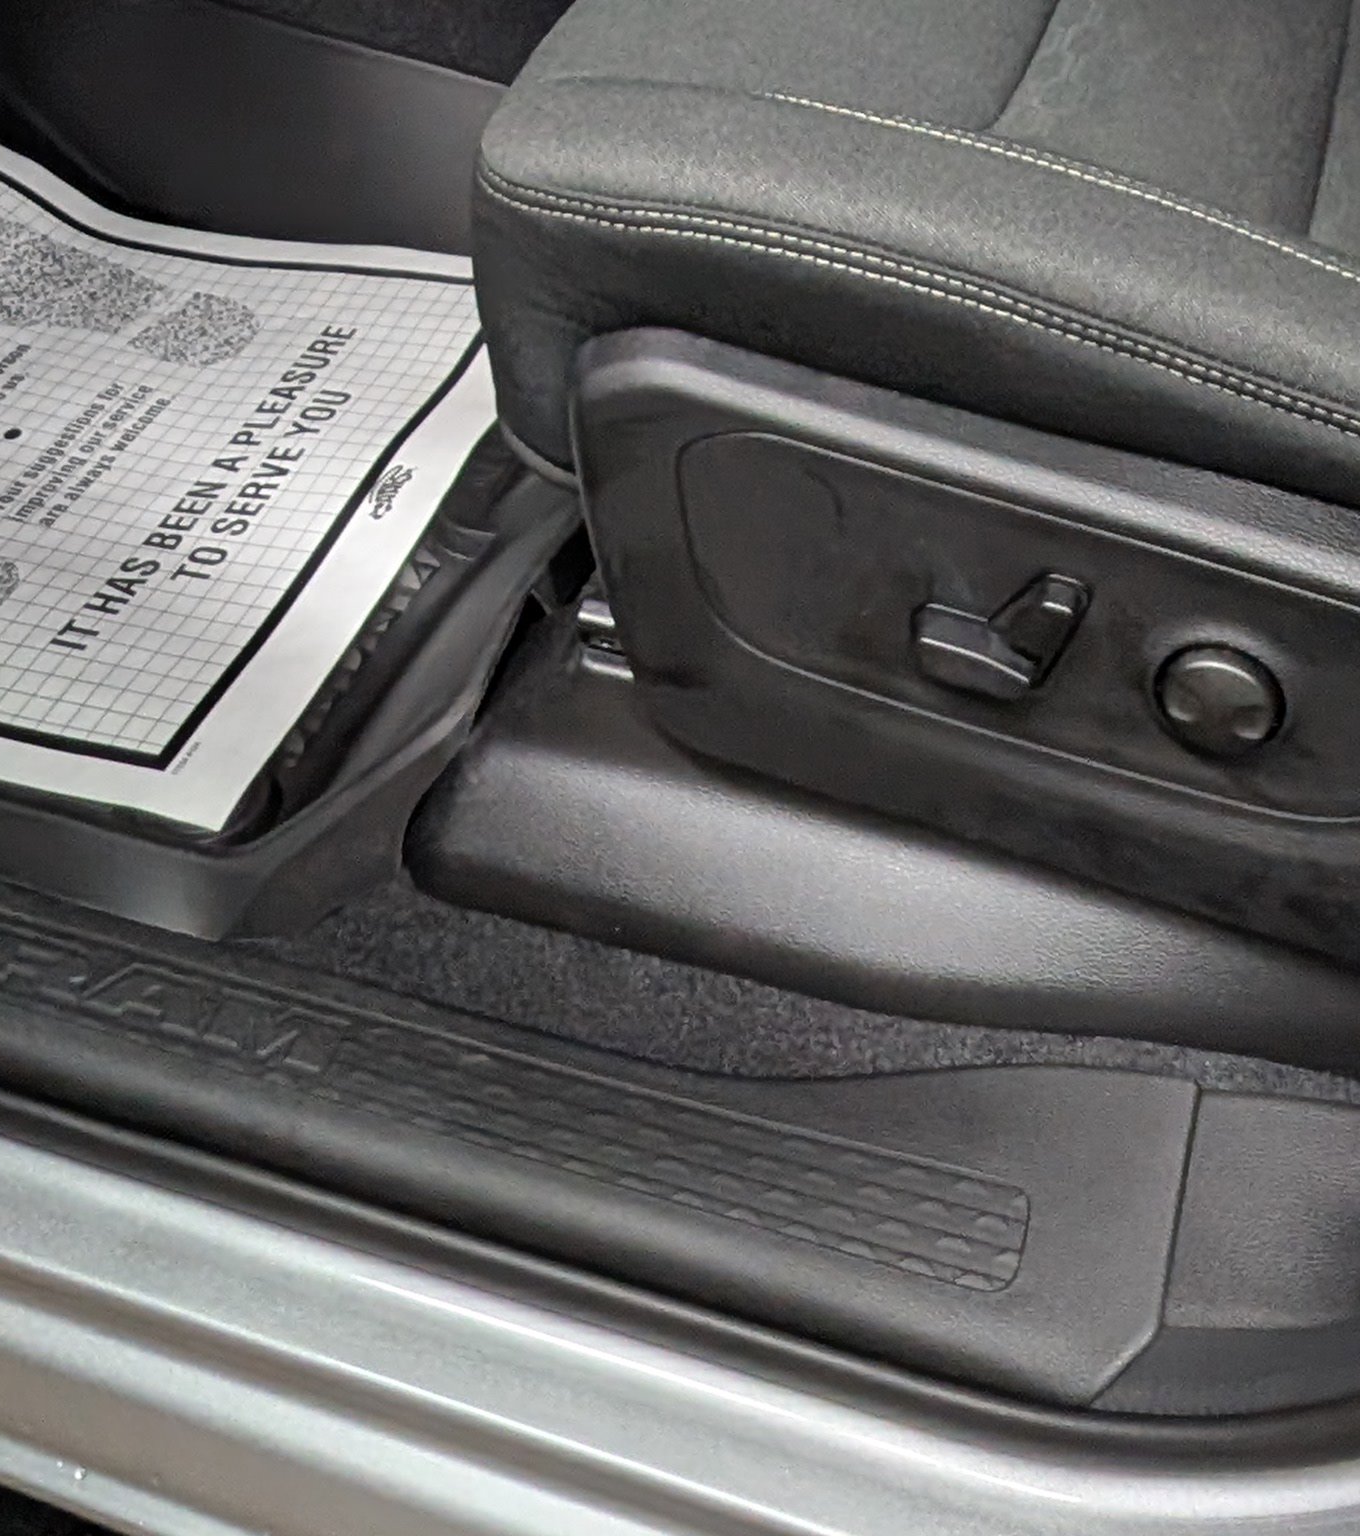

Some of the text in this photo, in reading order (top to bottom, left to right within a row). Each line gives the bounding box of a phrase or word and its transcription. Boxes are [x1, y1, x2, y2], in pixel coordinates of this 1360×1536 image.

[7, 384, 153, 522] improving our service
[23, 402, 105, 479] suggestions
[97, 382, 124, 401] for
[39, 502, 69, 528] are
[64, 454, 116, 501] always
[49, 324, 358, 651] IT HAS BEEN A PLEASURE
[170, 389, 352, 581] TO SERVE YOU
